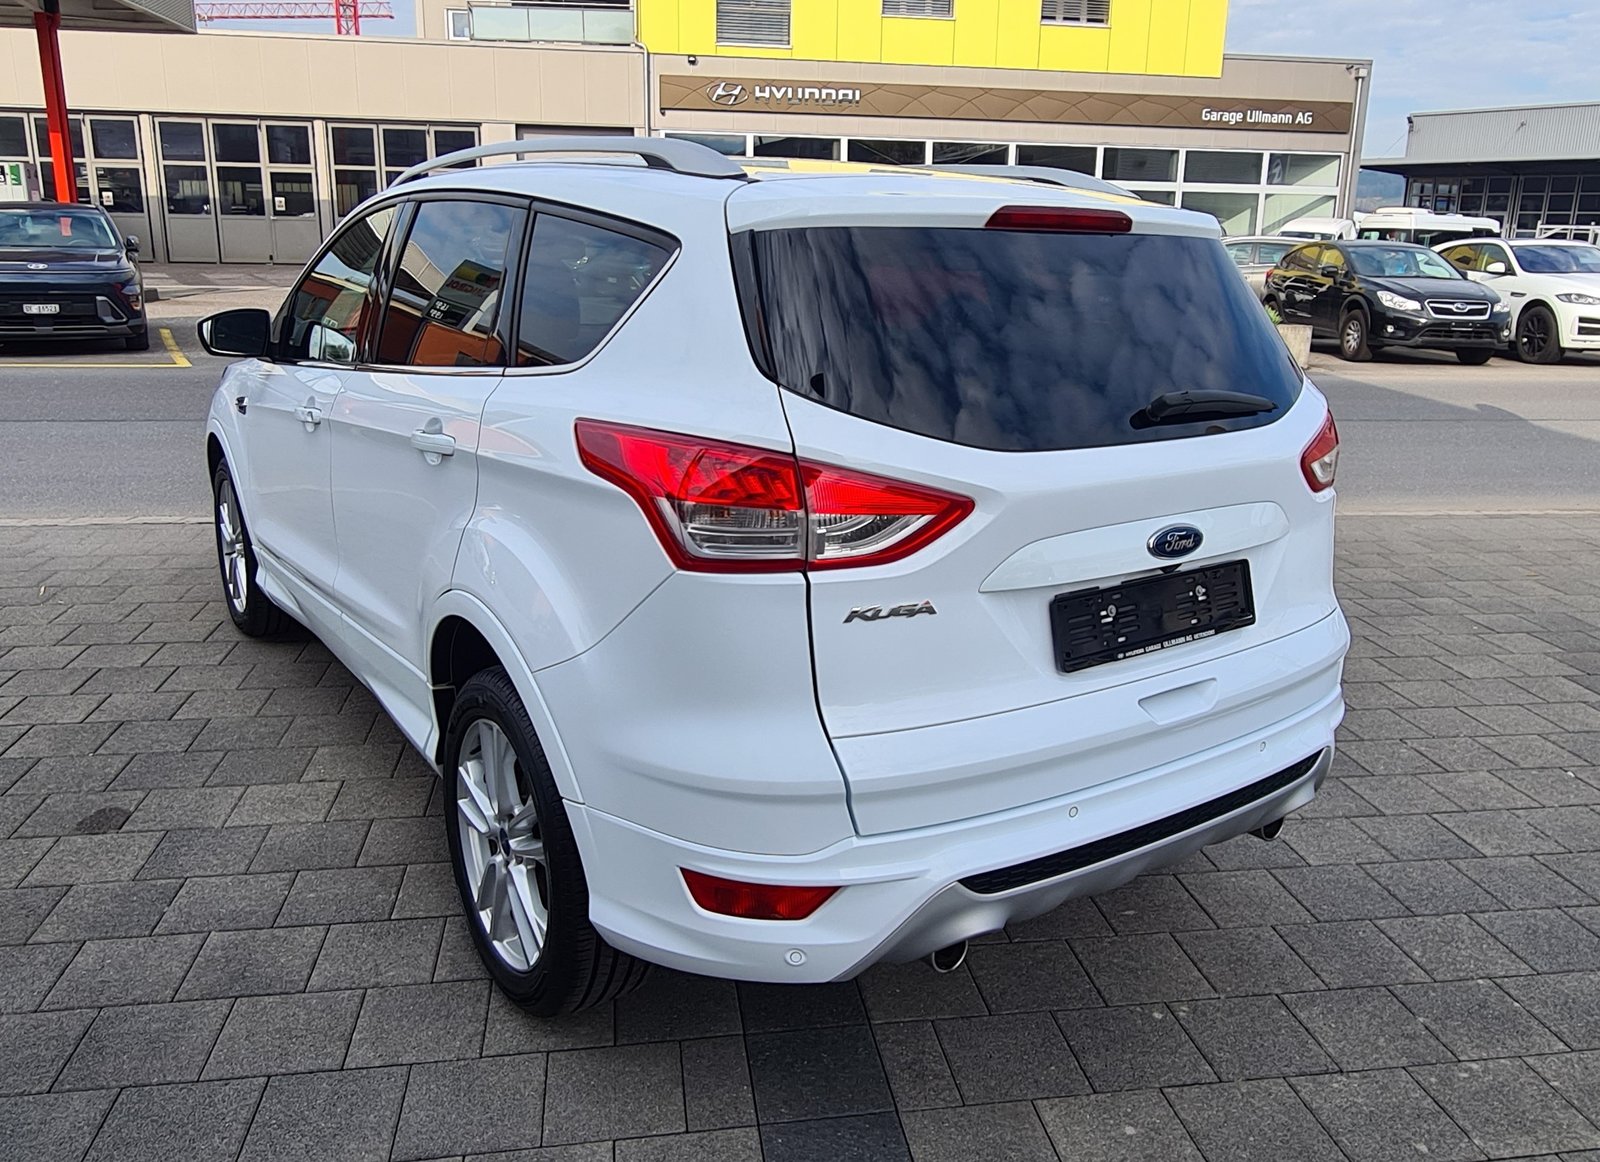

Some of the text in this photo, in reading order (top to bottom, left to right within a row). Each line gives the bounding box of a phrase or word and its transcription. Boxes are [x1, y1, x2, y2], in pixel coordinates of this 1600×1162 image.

[754, 85, 862, 107] HYUNDAI
[1201, 108, 1313, 125] Garage Ullmann AG
[1164, 531, 1196, 552] Ford
[842, 600, 938, 624] KUGA
